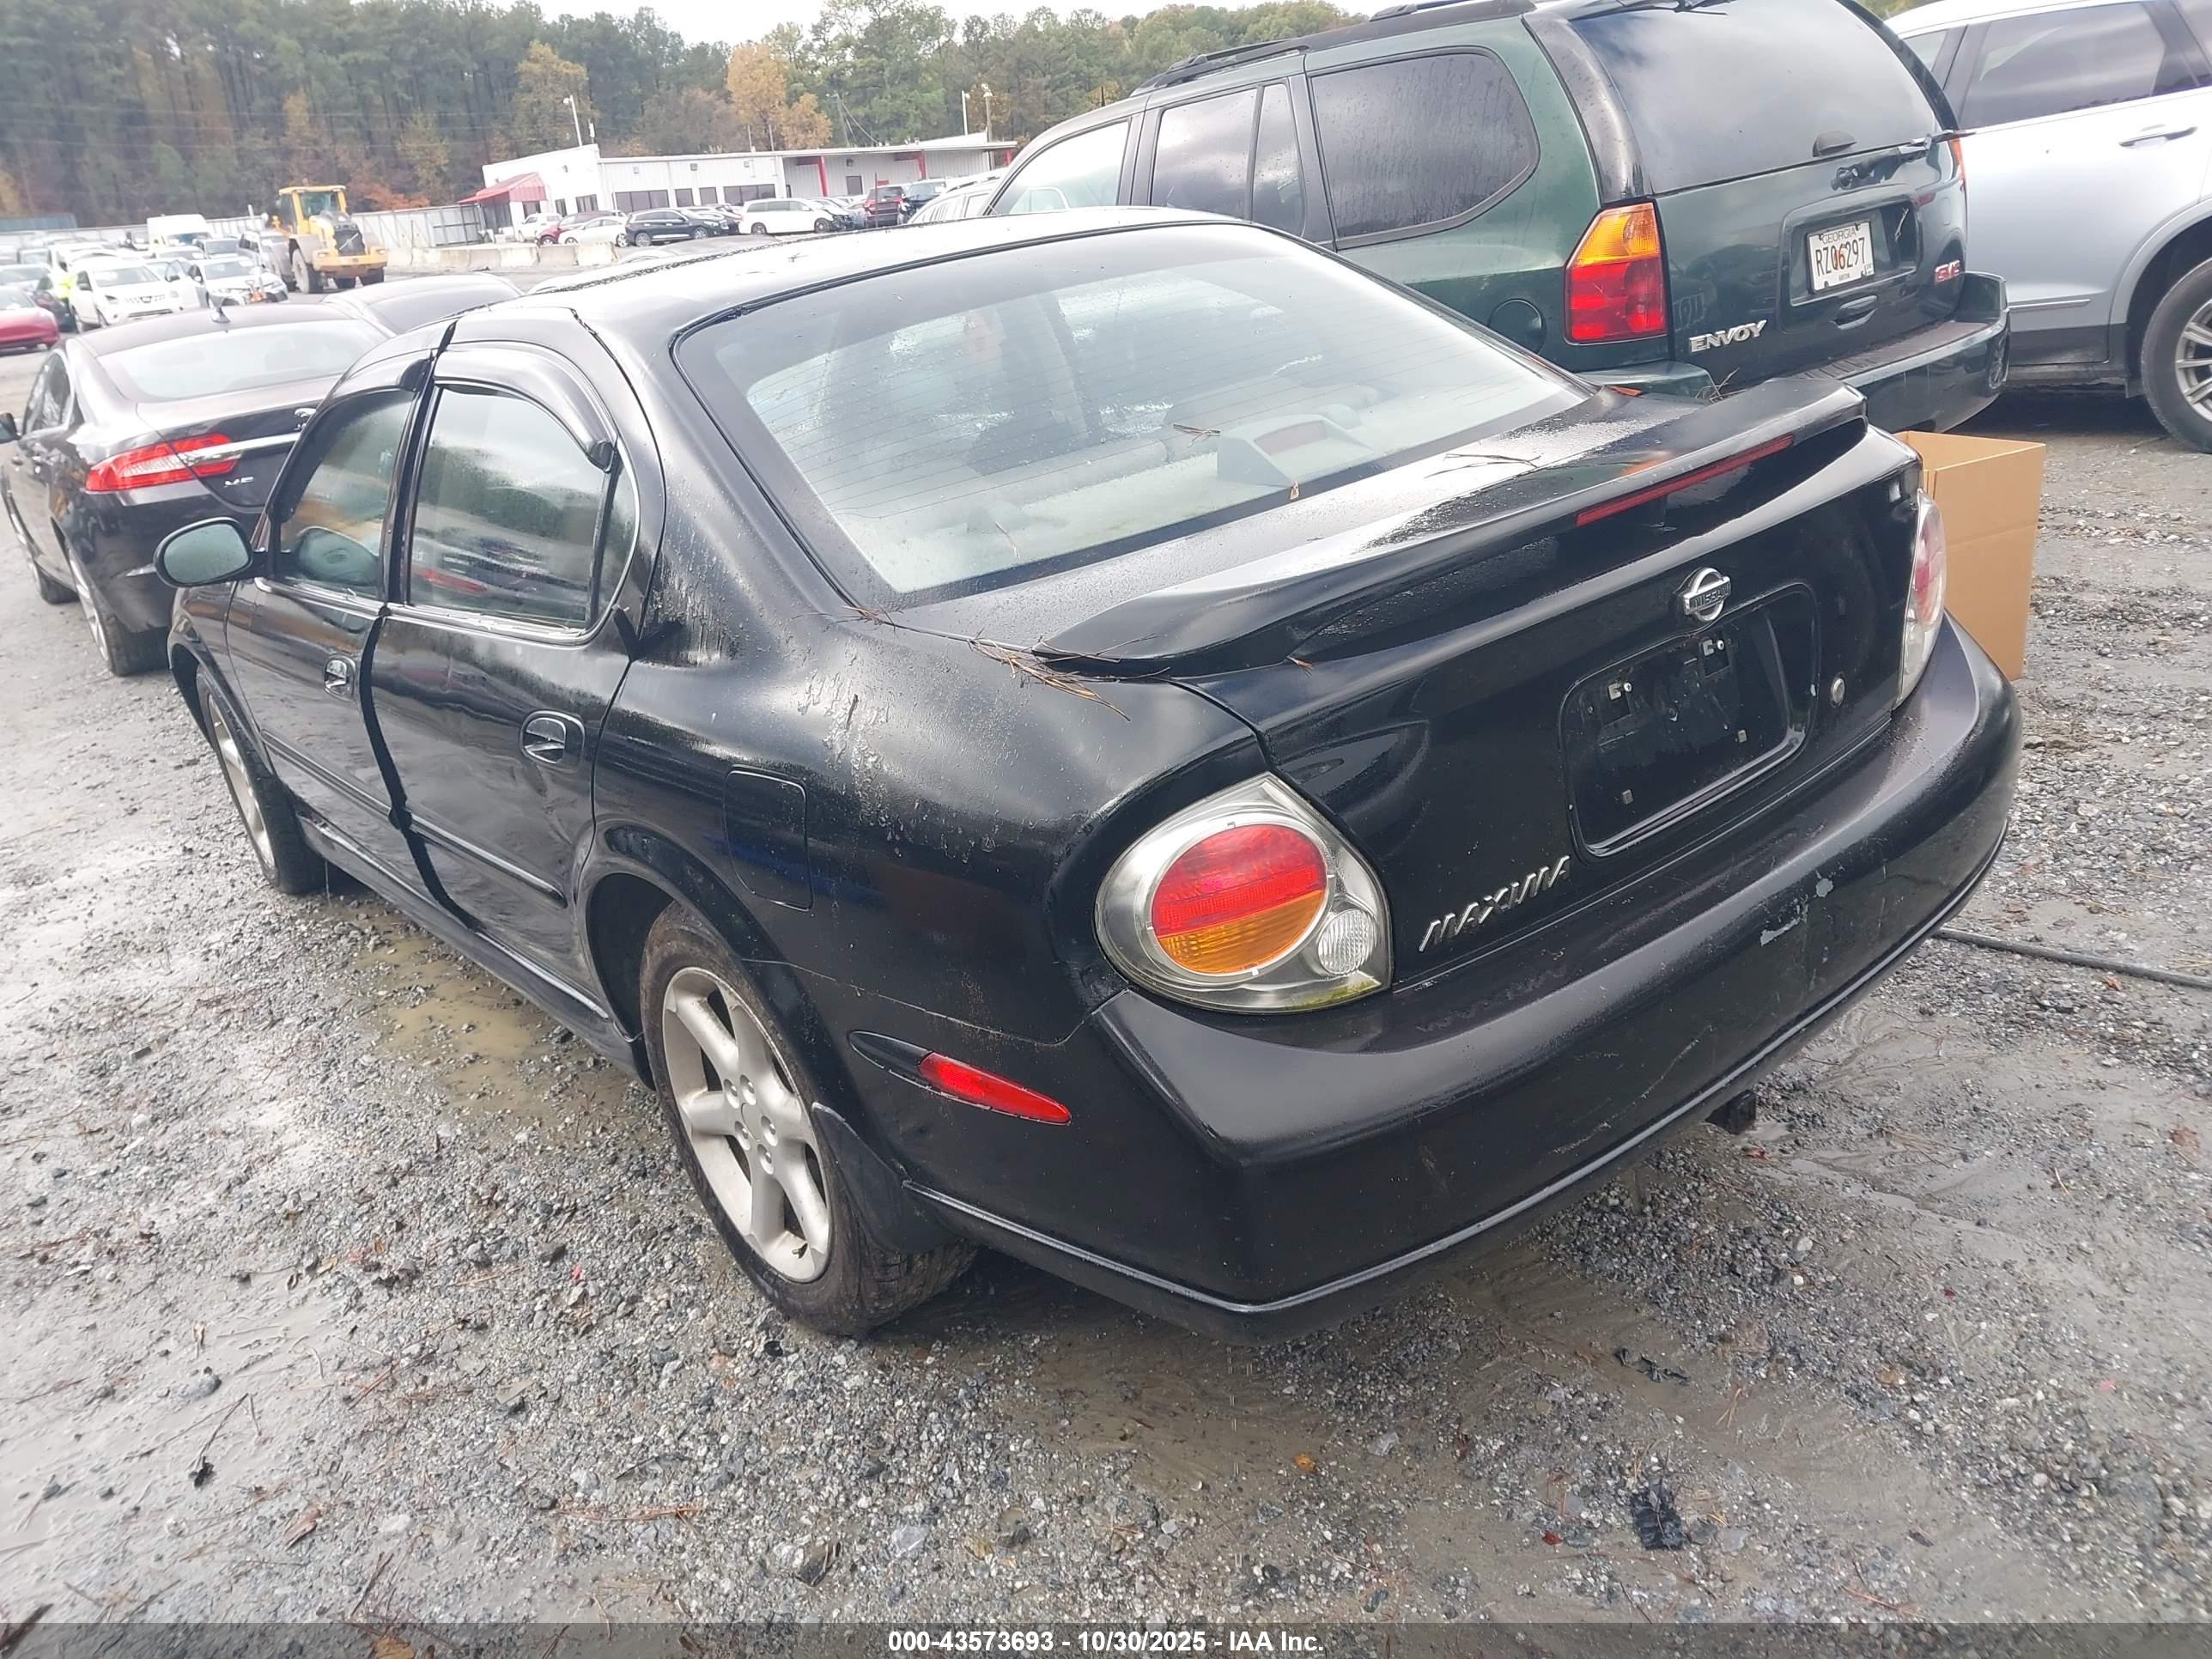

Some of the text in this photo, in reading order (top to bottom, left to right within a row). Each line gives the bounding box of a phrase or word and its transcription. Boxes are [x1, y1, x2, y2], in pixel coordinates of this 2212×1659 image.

[1821, 227, 1856, 245] GEORGIA
[1689, 319, 1767, 352] ENVOY
[1689, 582, 1730, 608] NISSAN
[1419, 855, 1571, 952] MAXIMA
